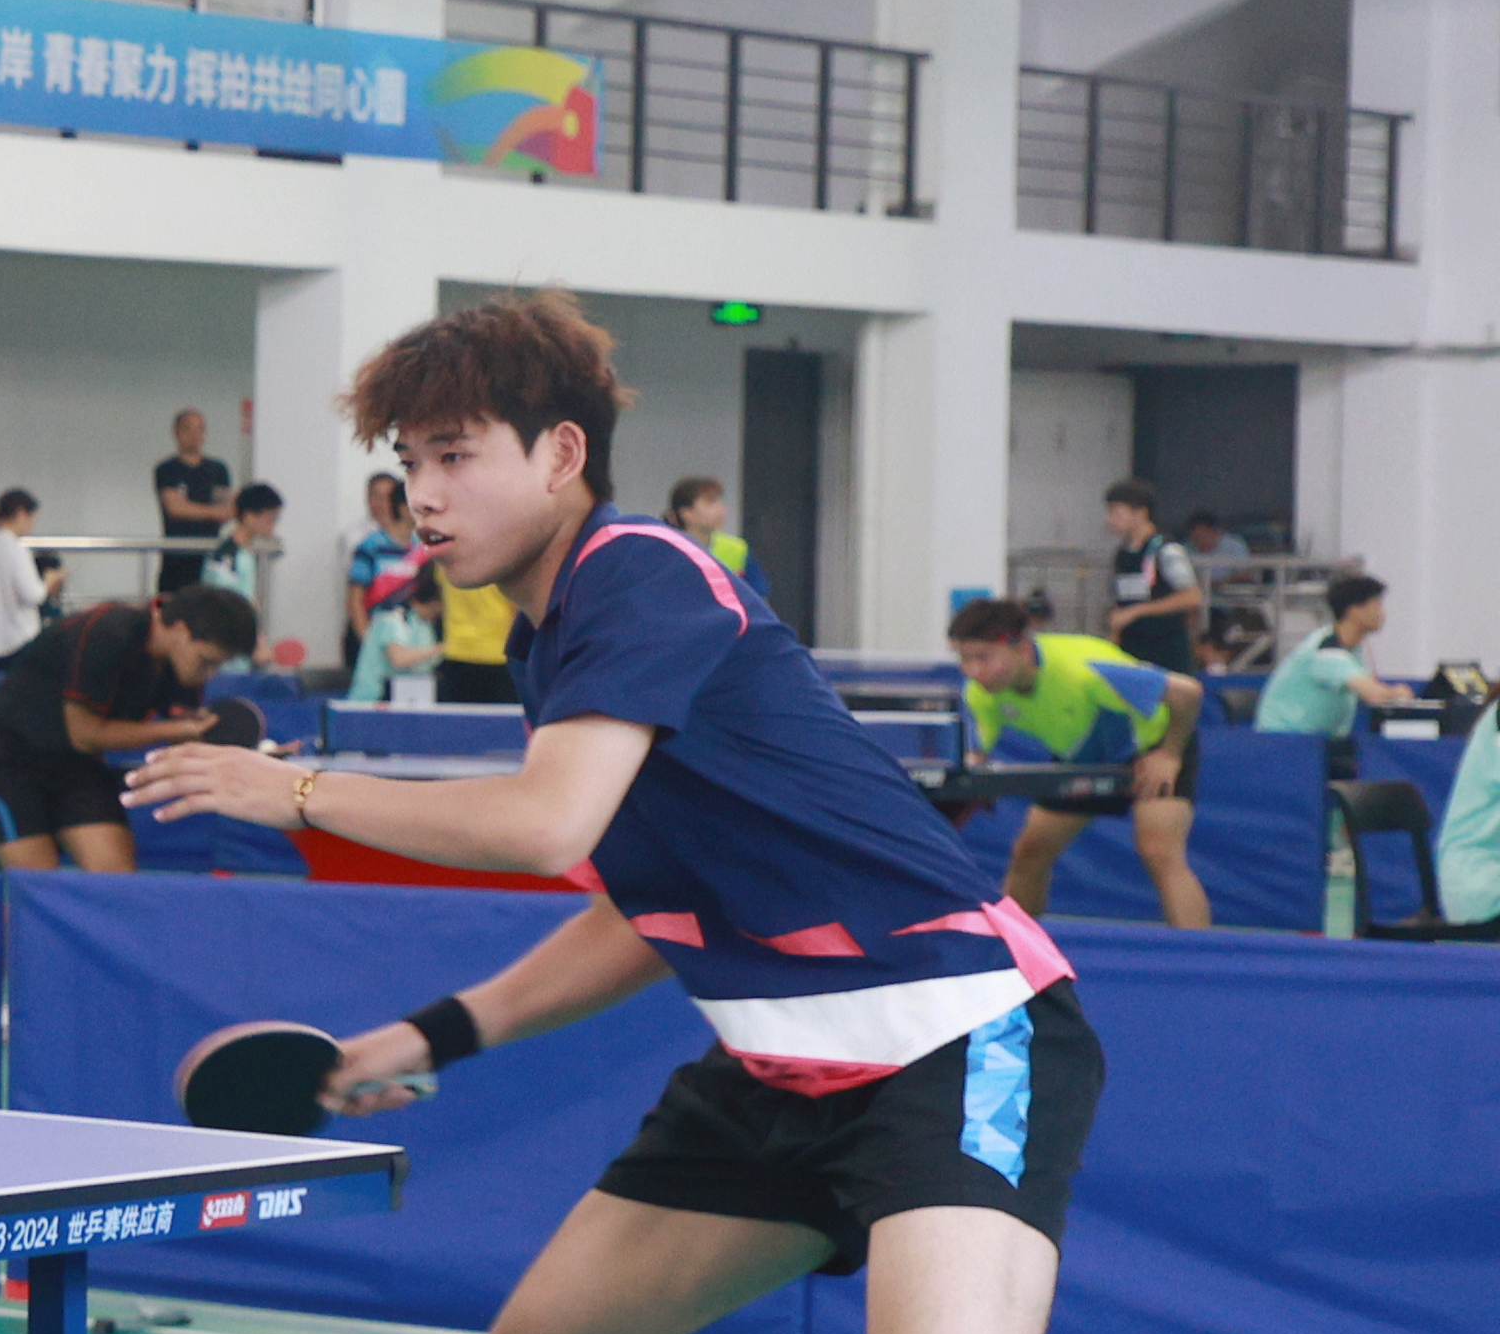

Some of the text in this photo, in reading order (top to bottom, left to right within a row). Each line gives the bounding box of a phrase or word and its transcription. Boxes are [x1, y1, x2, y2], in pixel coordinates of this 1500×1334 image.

[257, 1187, 307, 1219] DHS
[67, 1200, 175, 1246] 世乒赛供应商
